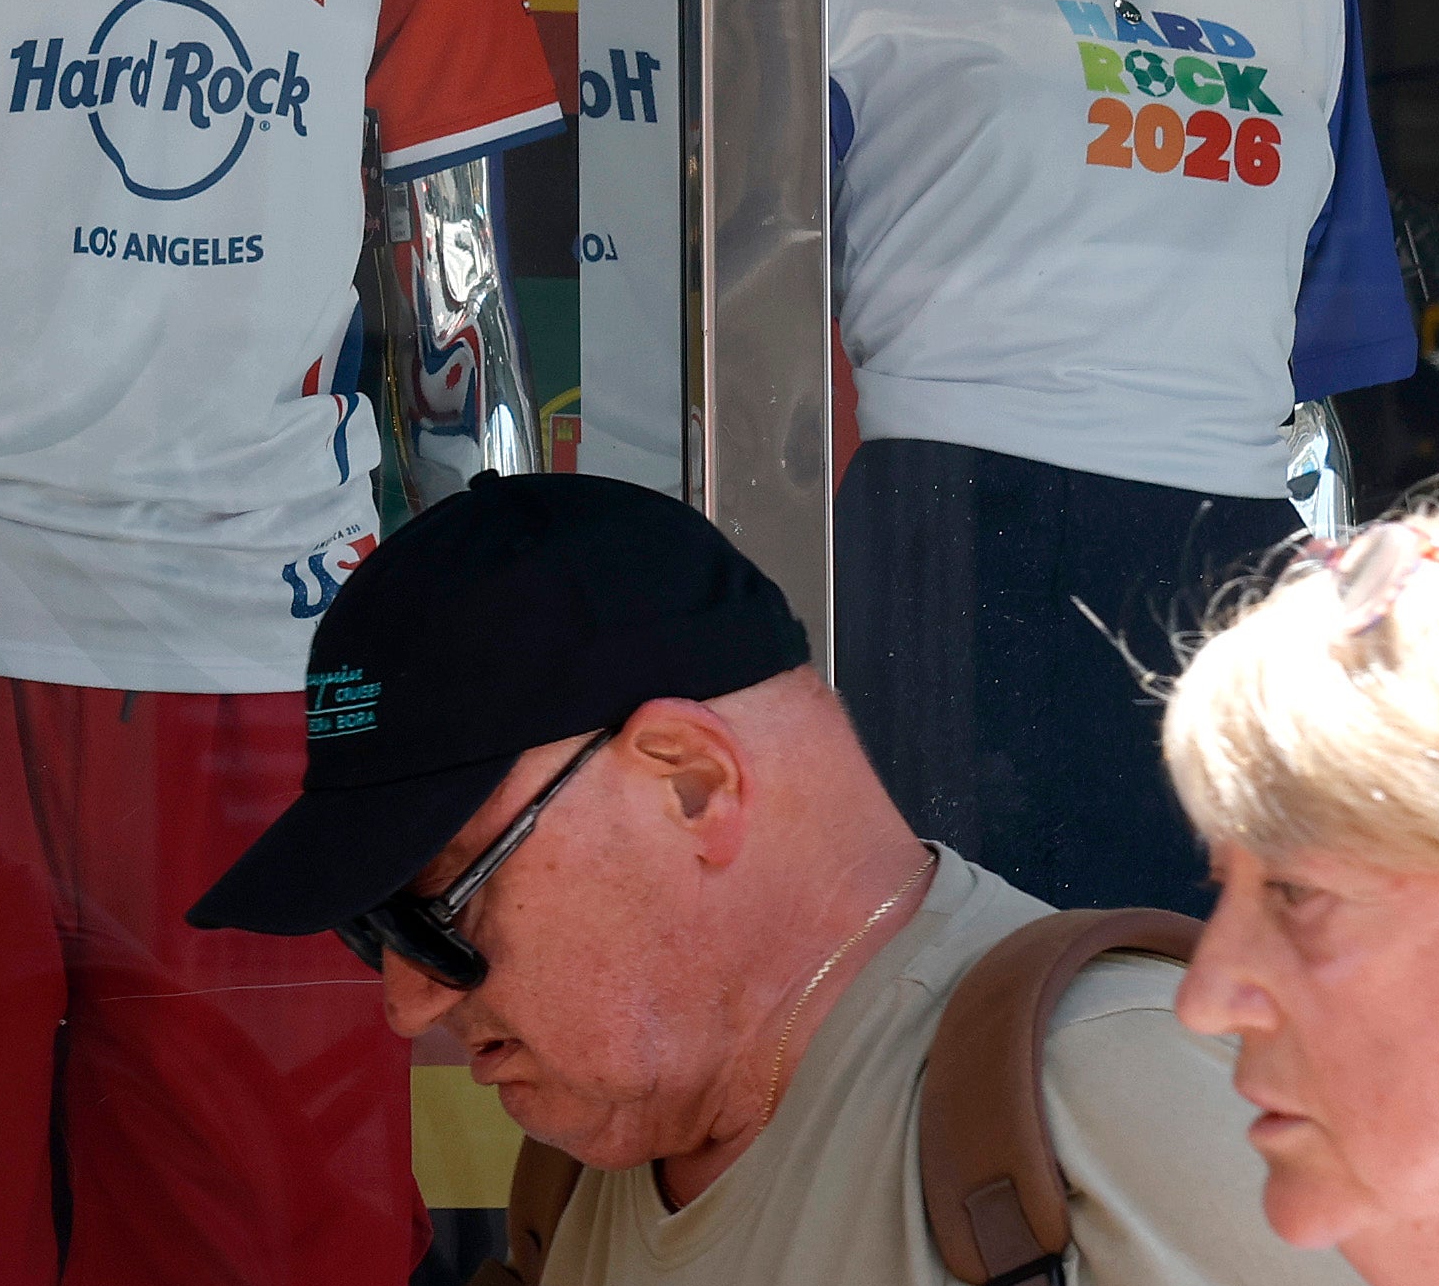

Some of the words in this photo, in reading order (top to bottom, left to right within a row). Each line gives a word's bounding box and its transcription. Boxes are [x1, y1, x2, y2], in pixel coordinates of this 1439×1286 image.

[1056, 0, 1257, 60] HARD
[9, 38, 158, 115] Hard
[164, 41, 311, 138] Rock
[1085, 97, 1282, 186] 2026
[72, 226, 118, 261] LOS
[122, 233, 265, 267] ANGELES
[334, 682, 382, 703] CRUISES
